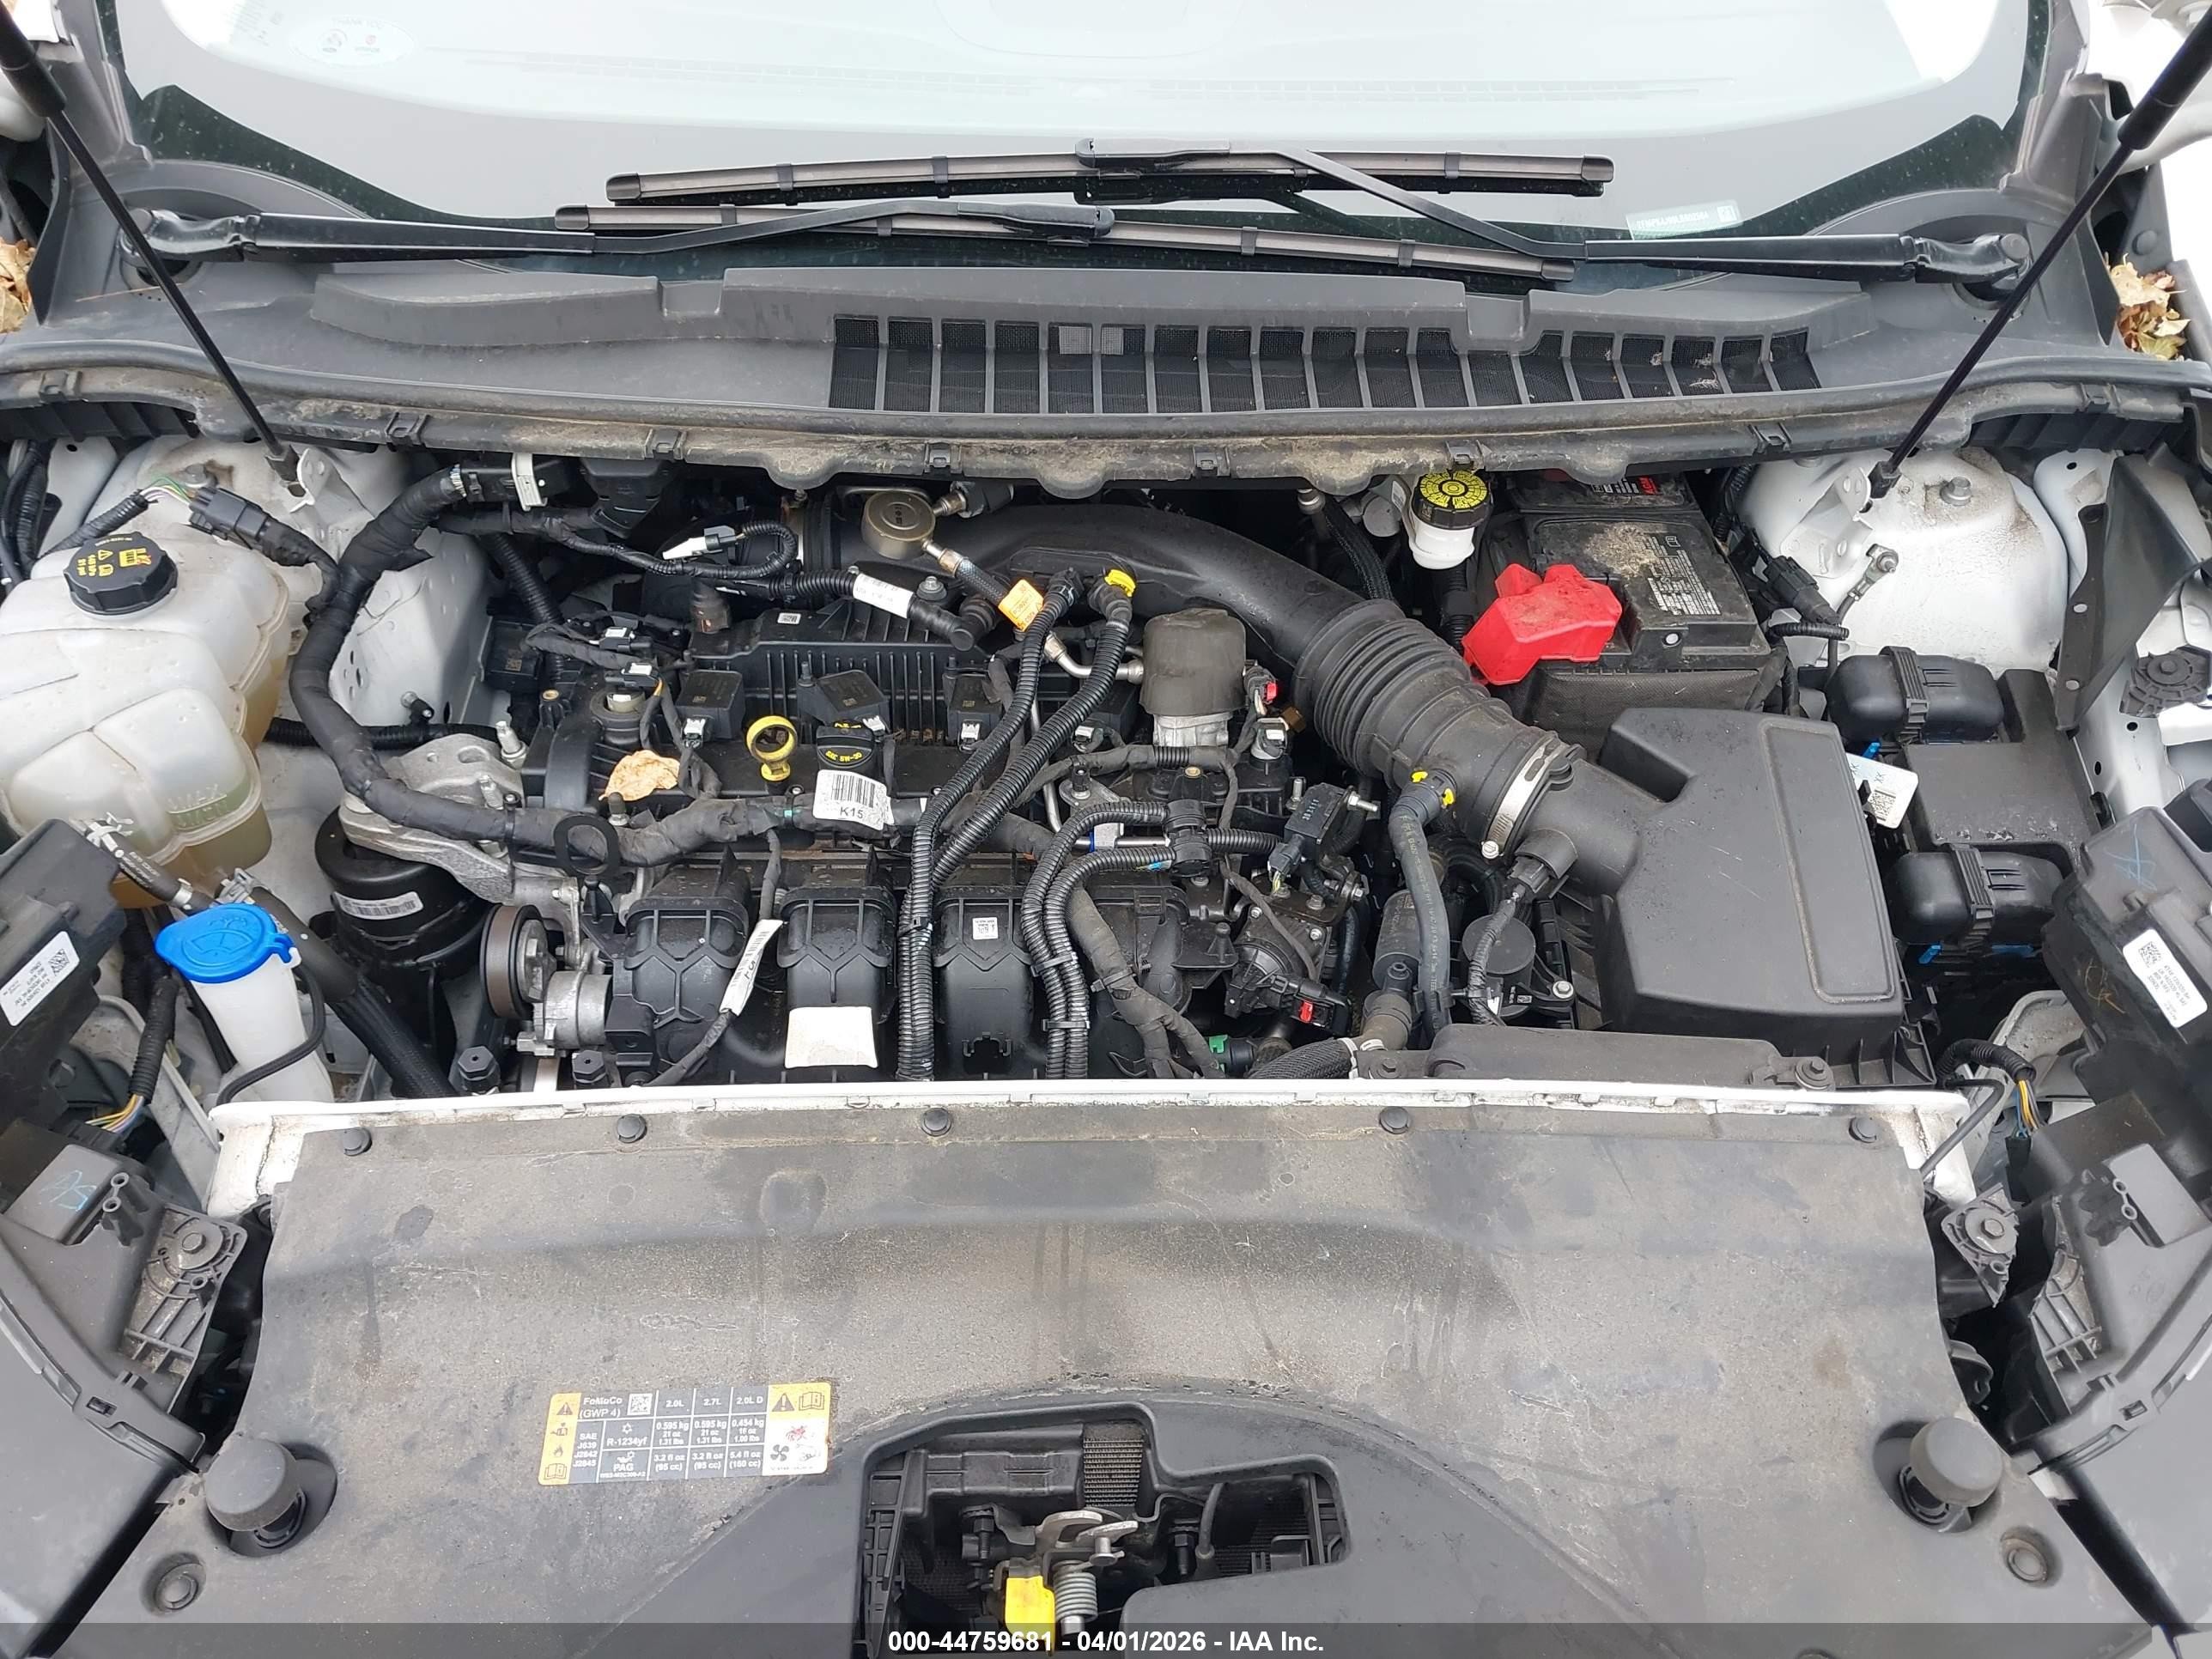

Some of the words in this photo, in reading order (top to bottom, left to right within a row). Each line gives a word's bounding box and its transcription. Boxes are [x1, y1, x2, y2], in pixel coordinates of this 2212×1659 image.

[825, 750, 838, 761] SAE
[839, 752, 862, 763] 5W-30
[840, 806, 864, 819] K15
[583, 1396, 623, 1405] FoMoCo
[579, 1409, 609, 1419] (GWP
[610, 1408, 621, 1418] 4)
[656, 1421, 678, 1430] 0.595
[679, 1420, 690, 1431] kg
[694, 1420, 716, 1429] 0.595
[717, 1419, 727, 1430] kg
[755, 1418, 765, 1428] kg
[606, 1437, 647, 1448] R-1234yf
[613, 1462, 635, 1472] PAG
[655, 1463, 668, 1472] (95
[670, 1462, 683, 1471] cc)
[694, 1462, 707, 1471] (95
[708, 1462, 721, 1470] cc)
[748, 1460, 761, 1468] cc)
